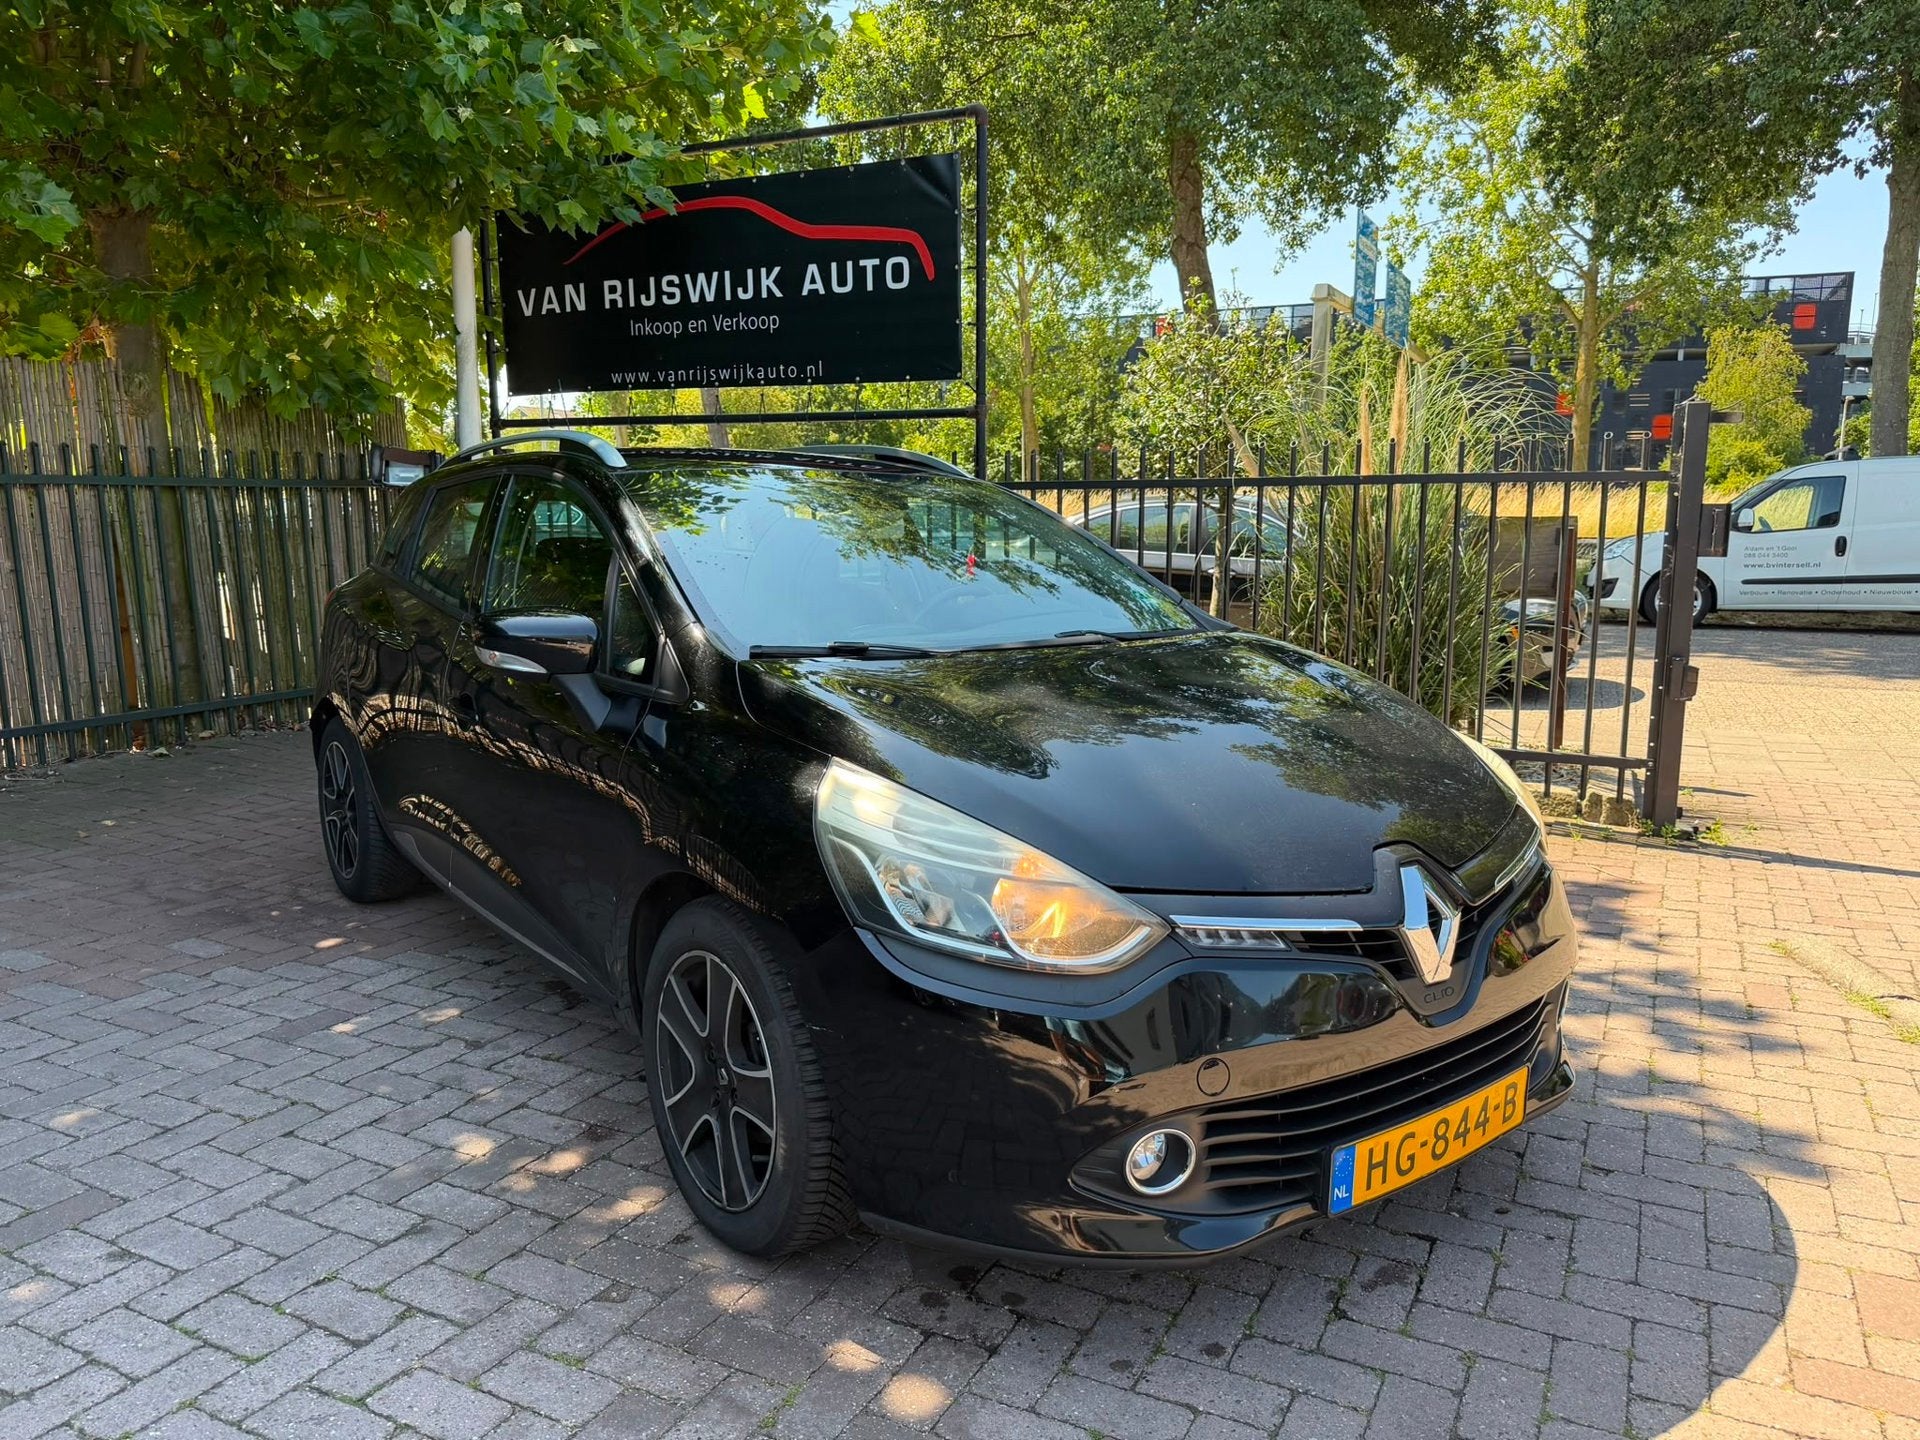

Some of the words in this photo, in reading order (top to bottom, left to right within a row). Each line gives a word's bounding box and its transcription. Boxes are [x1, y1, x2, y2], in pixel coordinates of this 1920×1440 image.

[517, 282, 587, 317] VAN
[603, 266, 784, 310] RIJSWIJK
[801, 255, 910, 296] AUTO
[629, 317, 683, 339] Inkoop
[687, 319, 708, 334] en
[712, 311, 780, 334] Verkoop
[610, 359, 824, 385] www.vanrijswijkauto.nl
[1423, 986, 1455, 1004] CLIO
[1365, 1081, 1519, 1191] HG-844-B
[1333, 1184, 1350, 1201] NL
